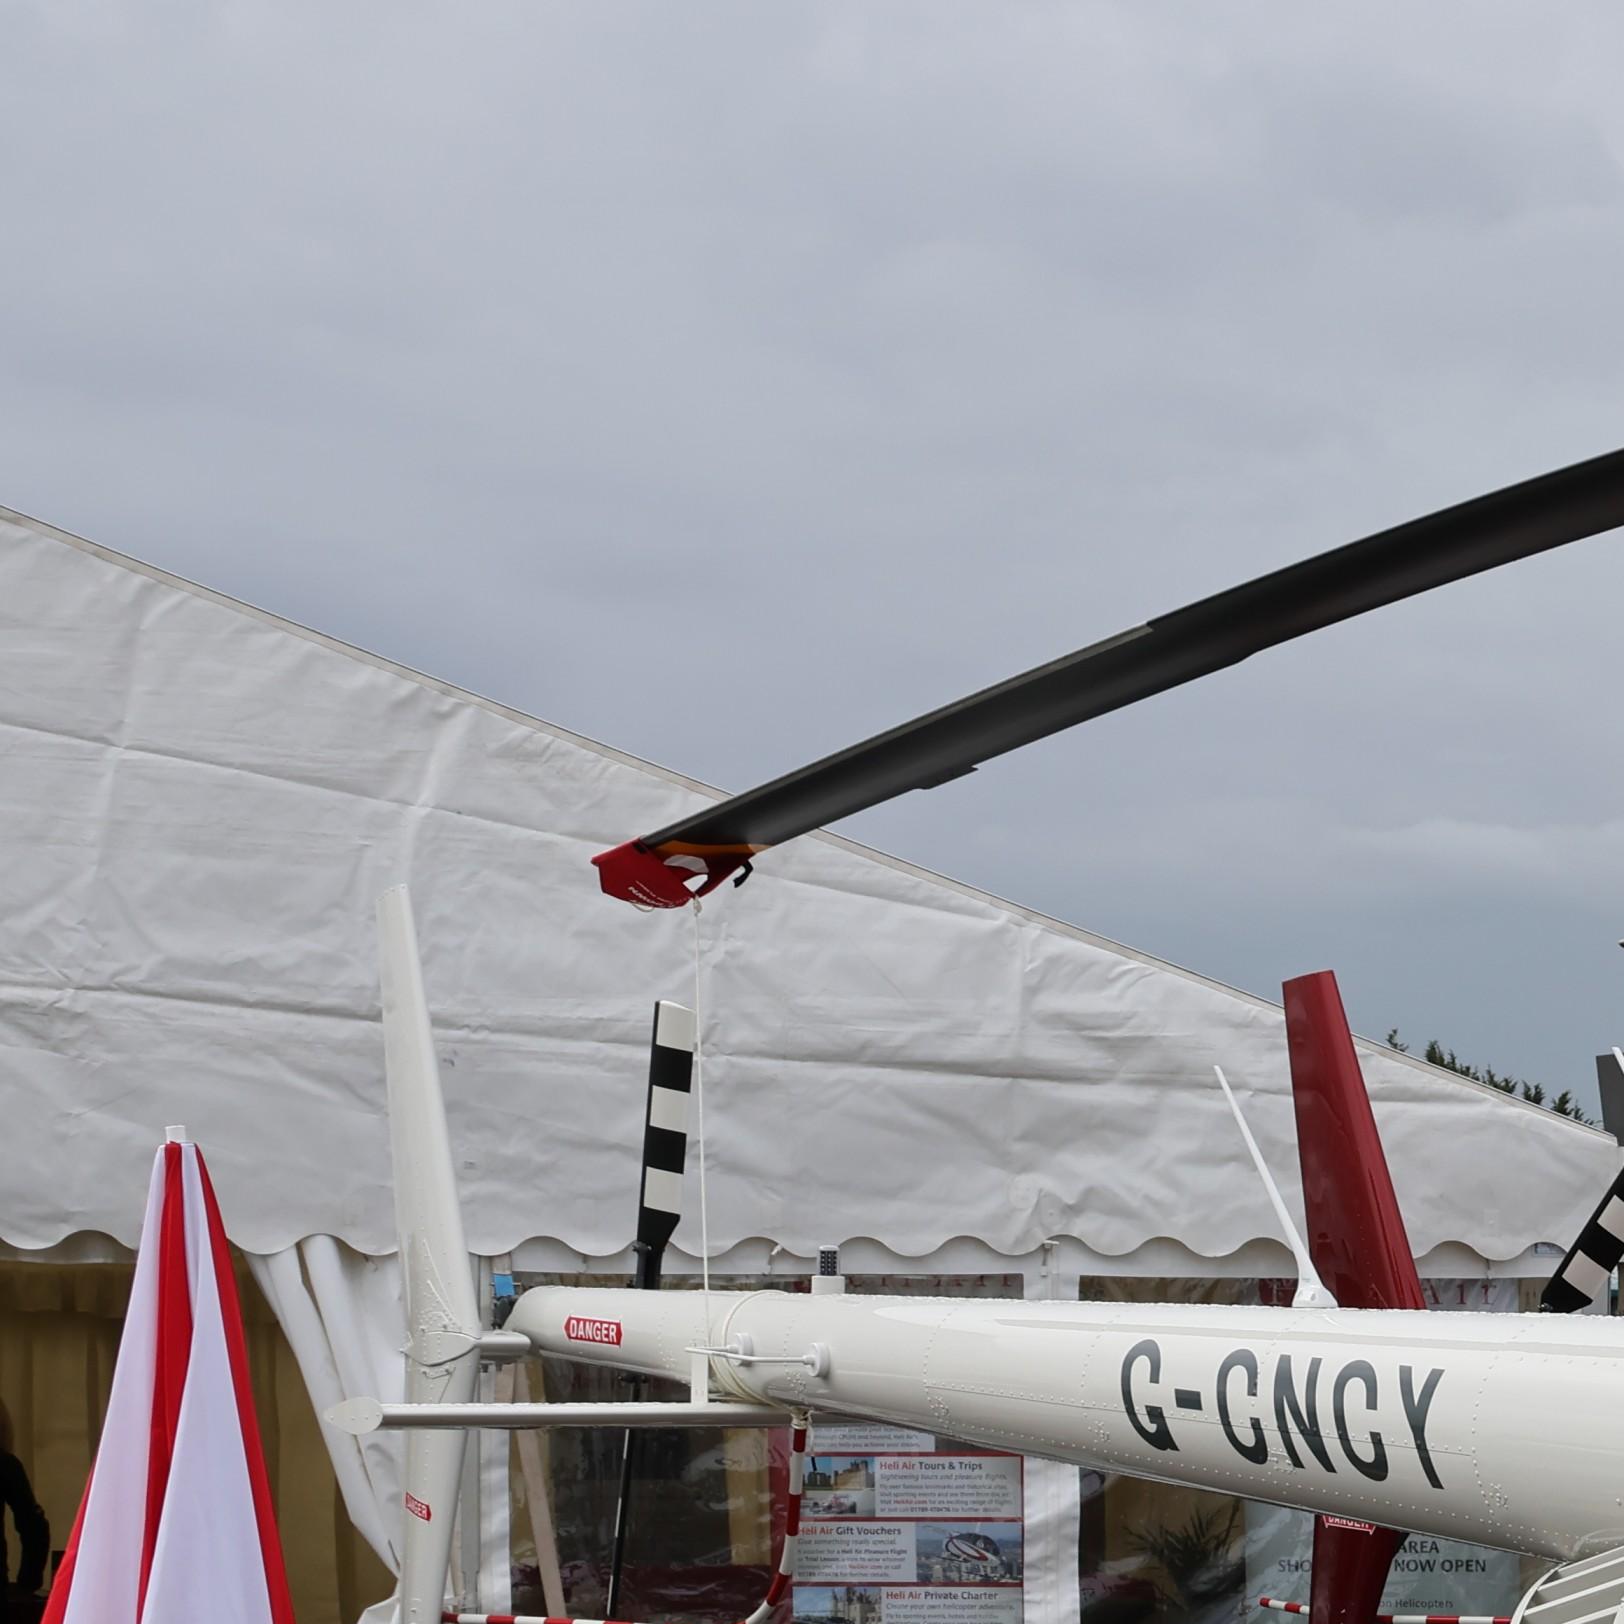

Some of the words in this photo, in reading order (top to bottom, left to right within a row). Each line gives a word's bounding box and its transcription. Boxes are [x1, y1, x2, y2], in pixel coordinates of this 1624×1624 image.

[569, 1319, 617, 1343] DANGER
[1121, 1338, 1446, 1490] G-CNCY
[880, 1461, 899, 1470] Heli
[902, 1461, 915, 1470] Air
[918, 1461, 945, 1470] Tours
[948, 1461, 955, 1470] &
[958, 1461, 983, 1472] Trips
[798, 1526, 817, 1535] Heli
[819, 1526, 834, 1535] Air
[836, 1526, 854, 1535] Gift
[857, 1526, 902, 1535] Vouchers
[1394, 1560, 1436, 1573] NOW
[1440, 1560, 1486, 1573] OPEN
[886, 1591, 905, 1600] Heli
[907, 1591, 921, 1600] Air
[924, 1591, 958, 1600] Private
[961, 1591, 998, 1600] Charter
[1395, 1600, 1453, 1610] Helicopters
